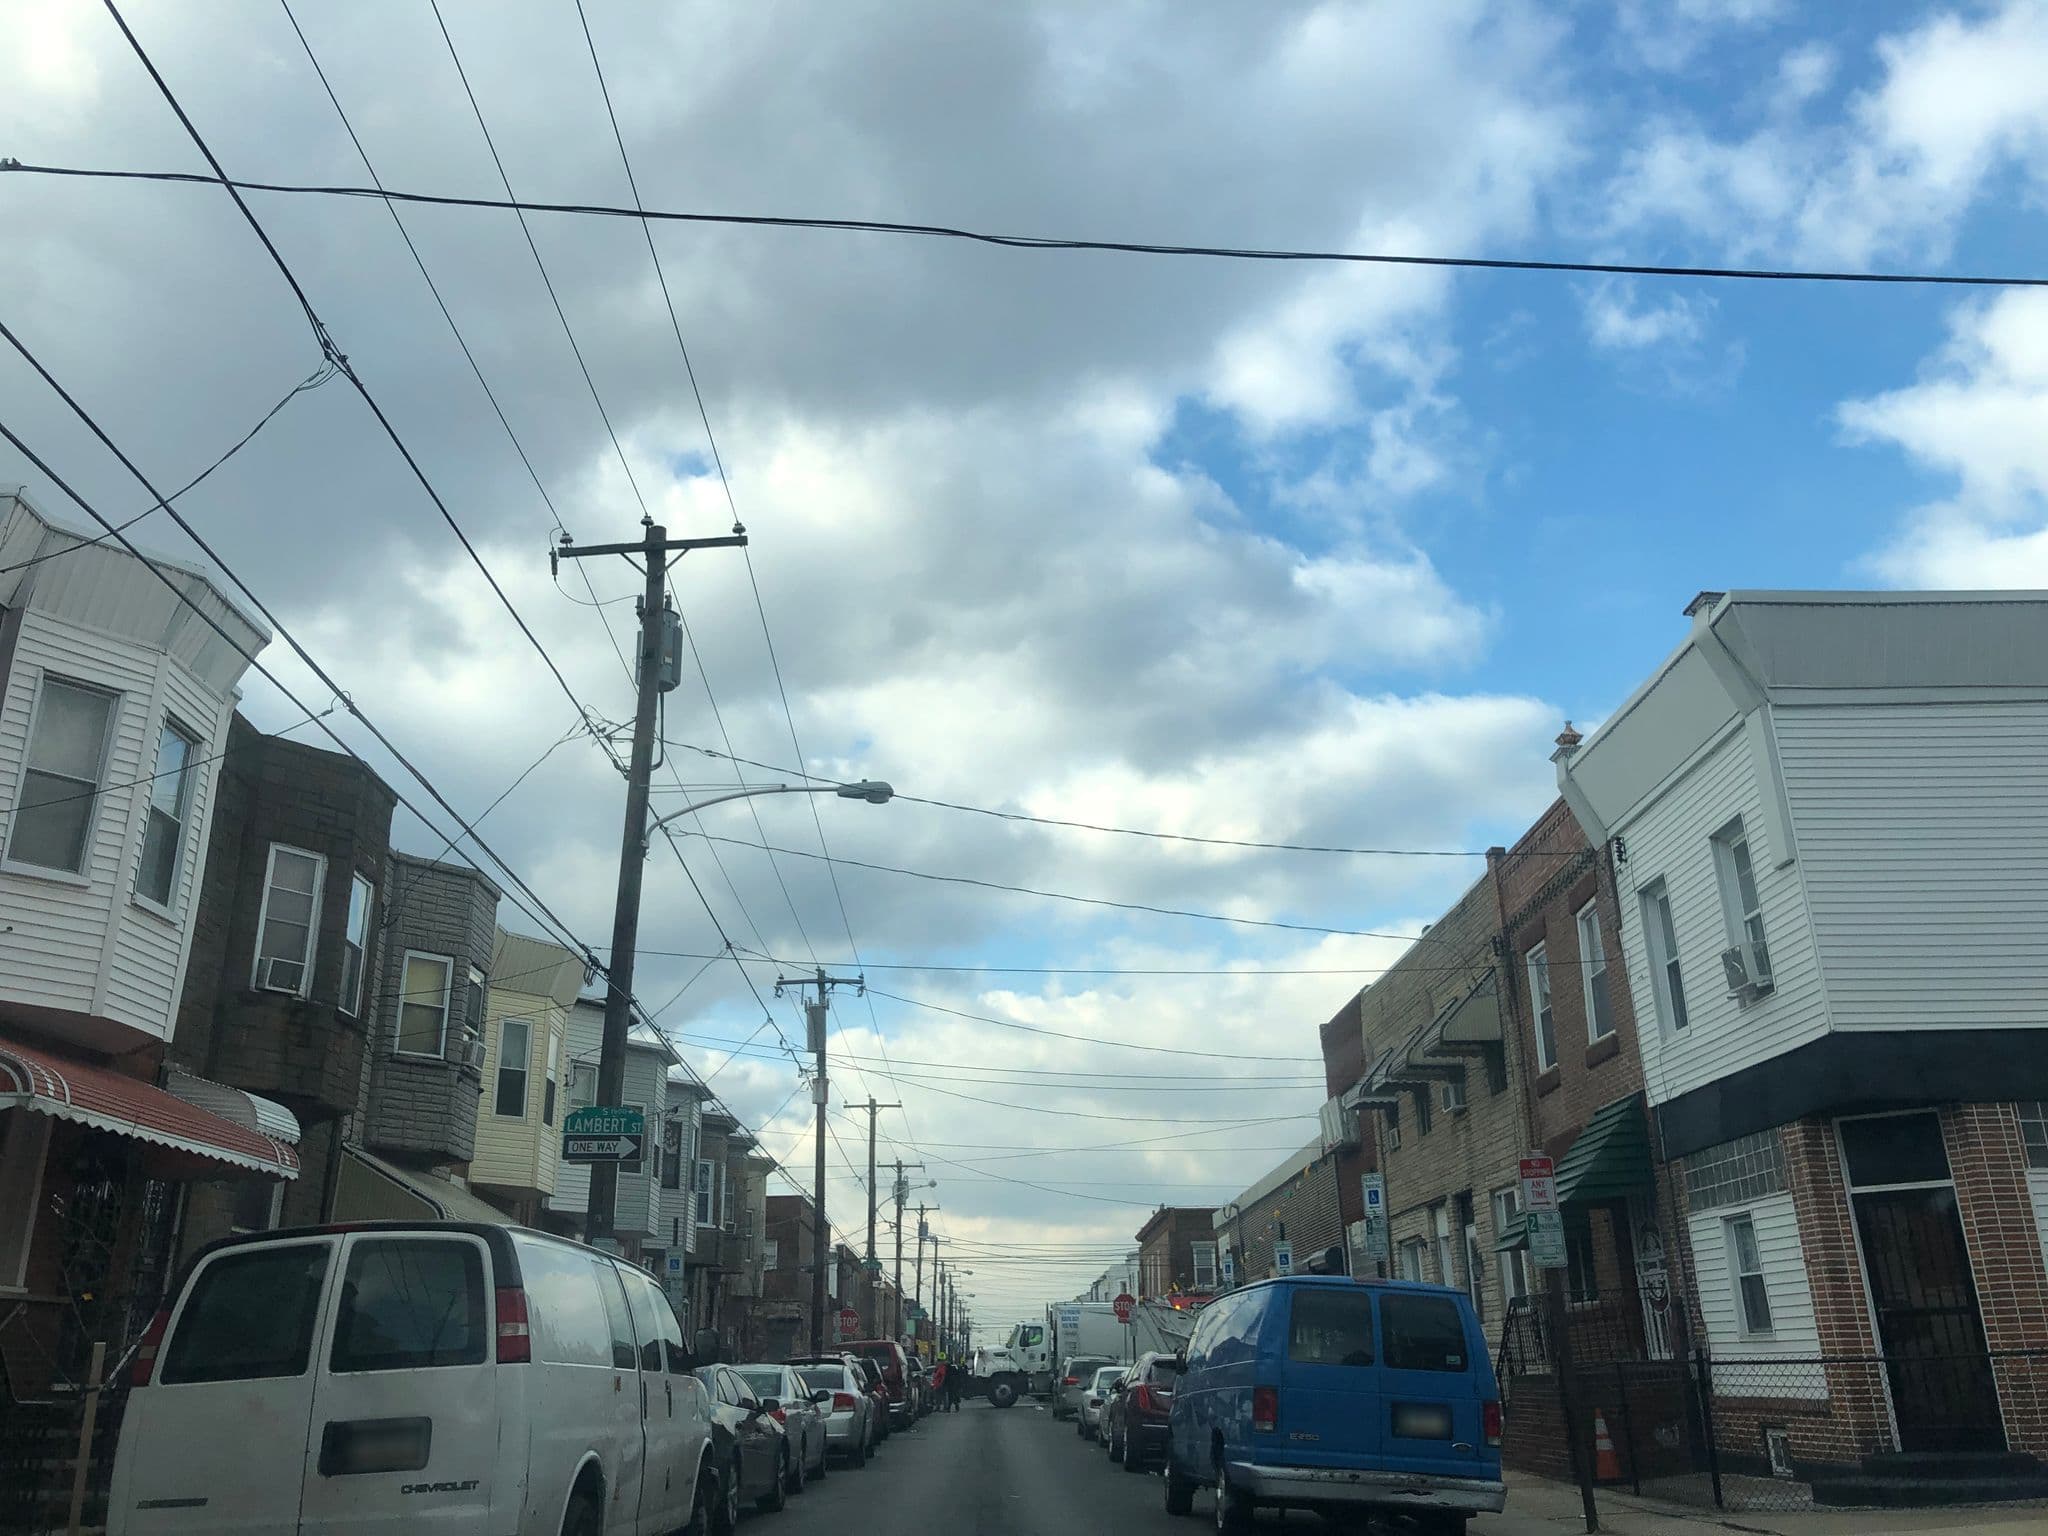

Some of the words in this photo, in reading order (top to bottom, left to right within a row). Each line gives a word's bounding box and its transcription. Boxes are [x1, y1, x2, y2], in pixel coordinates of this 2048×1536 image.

[602, 1107, 609, 1116] S
[567, 1118, 627, 1133] LAMBERT
[631, 1122, 642, 1133] ST
[572, 1142, 593, 1152] ONE
[597, 1142, 619, 1152] WAY
[1531, 1180, 1546, 1189] ANY
[1531, 1190, 1548, 1199] TIME
[1530, 1216, 1537, 1230] 2
[400, 1480, 480, 1494] CHEVROLET
